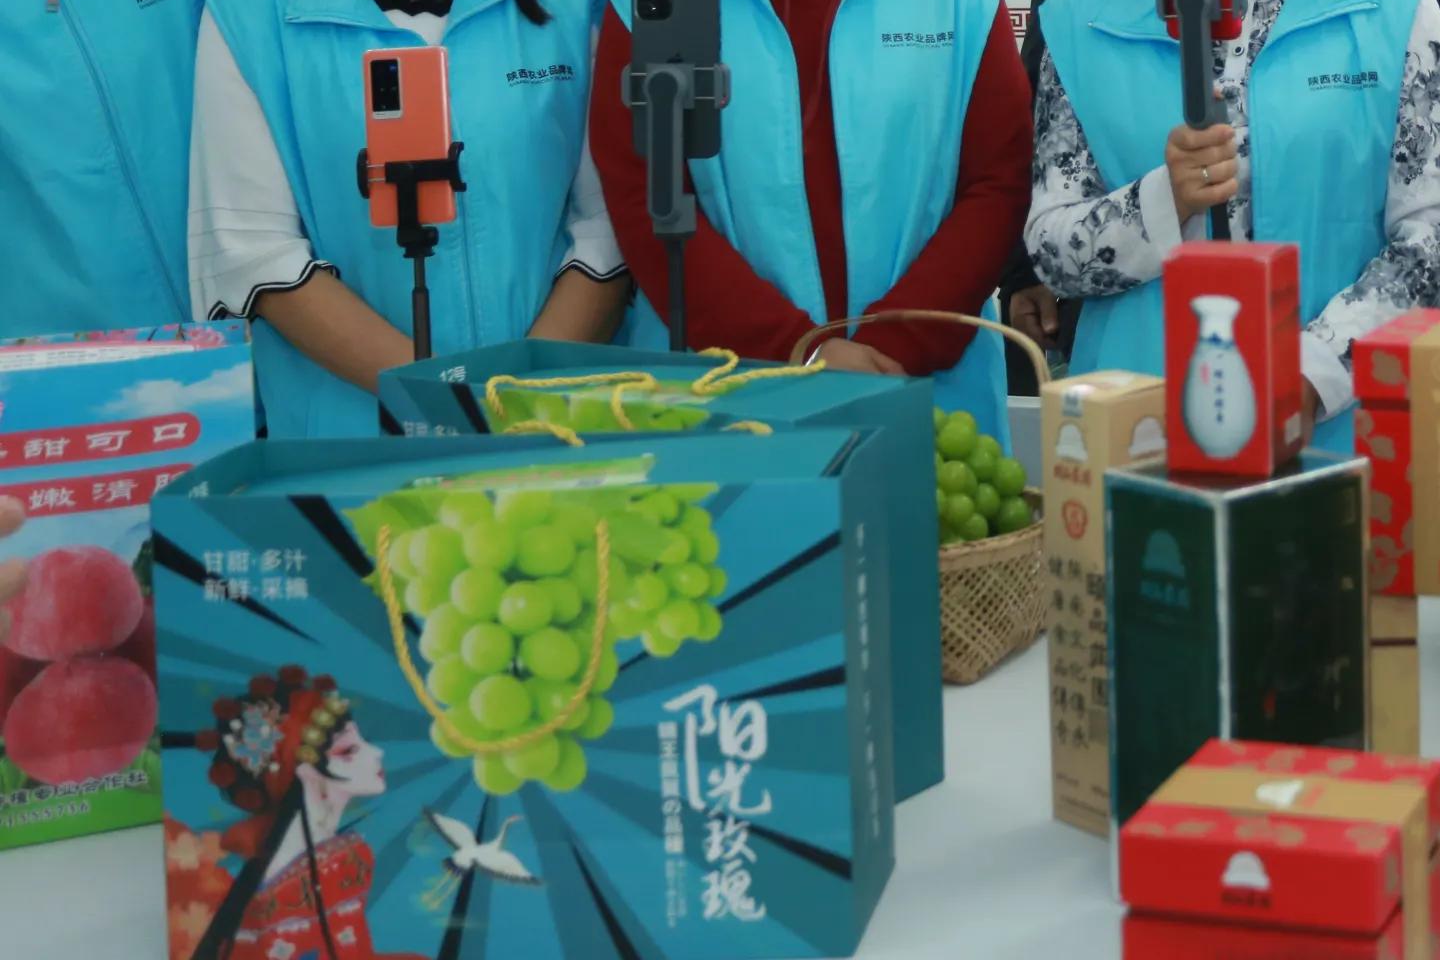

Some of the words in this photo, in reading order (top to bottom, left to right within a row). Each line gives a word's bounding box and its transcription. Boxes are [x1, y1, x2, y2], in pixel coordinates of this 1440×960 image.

[0, 422, 188, 460] 甜可口
[662, 684, 772, 922] 阳光玫瑰
